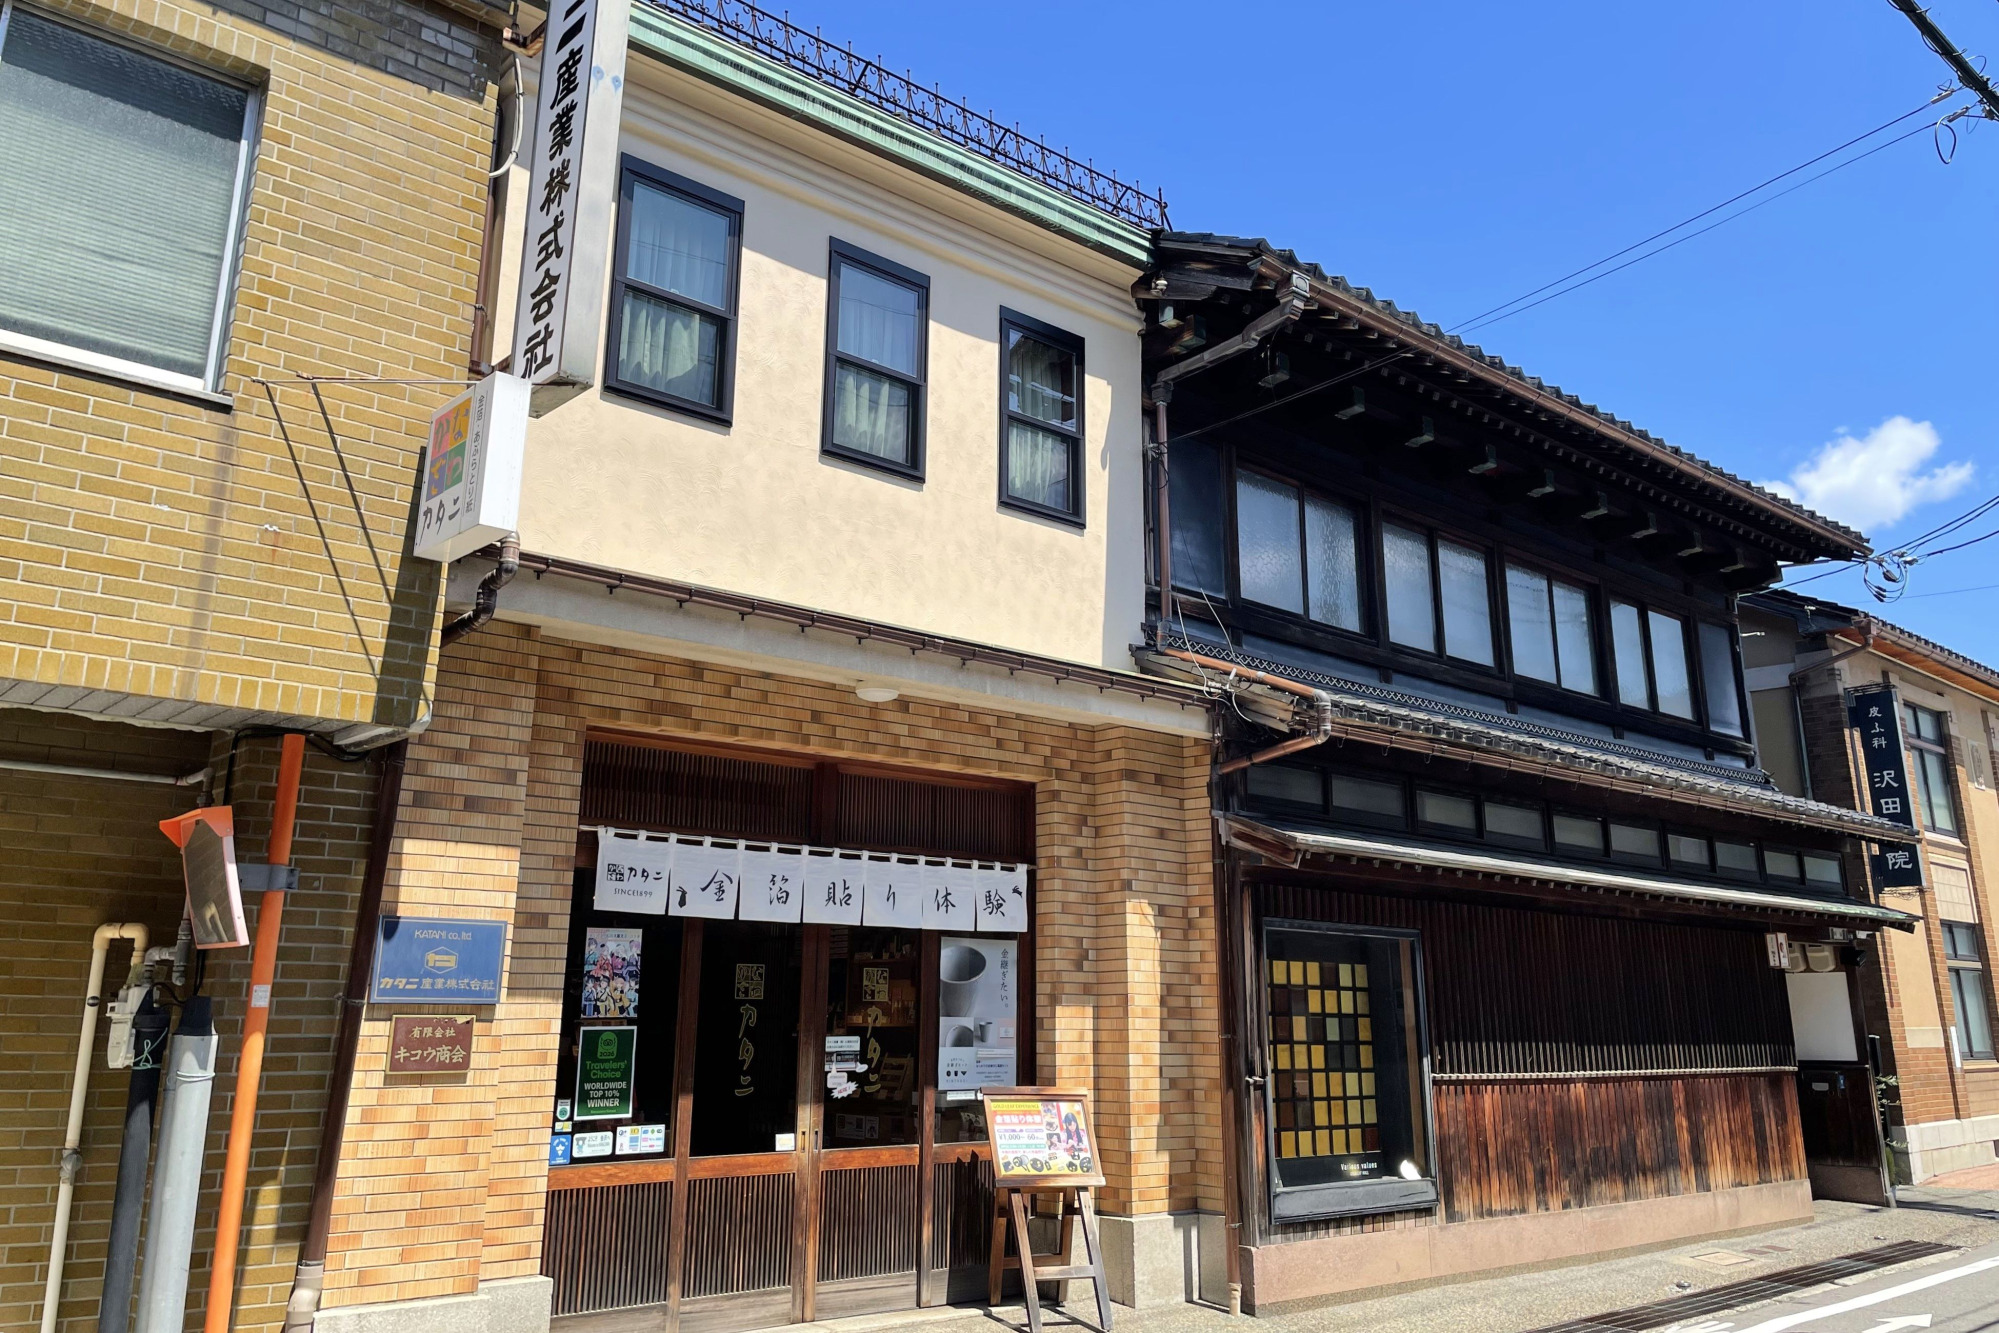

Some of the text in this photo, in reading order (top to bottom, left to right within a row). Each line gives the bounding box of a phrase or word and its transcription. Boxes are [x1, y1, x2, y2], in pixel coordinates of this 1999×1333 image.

[419, 495, 461, 546] カタニ
[1868, 705, 1888, 749] 皮ふ科
[627, 866, 663, 883] カタニ
[415, 929, 447, 940] KATANI
[409, 1026, 457, 1039] 有限会社
[394, 1045, 467, 1063] キコウ商会
[734, 1003, 757, 1097] カタニ
[864, 1005, 882, 1093] カタニ
[590, 1070, 621, 1079] Choice
[584, 1081, 627, 1090] WORLDWIDE
[605, 1090, 620, 1098] 10%
[587, 1098, 620, 1108] WINNER
